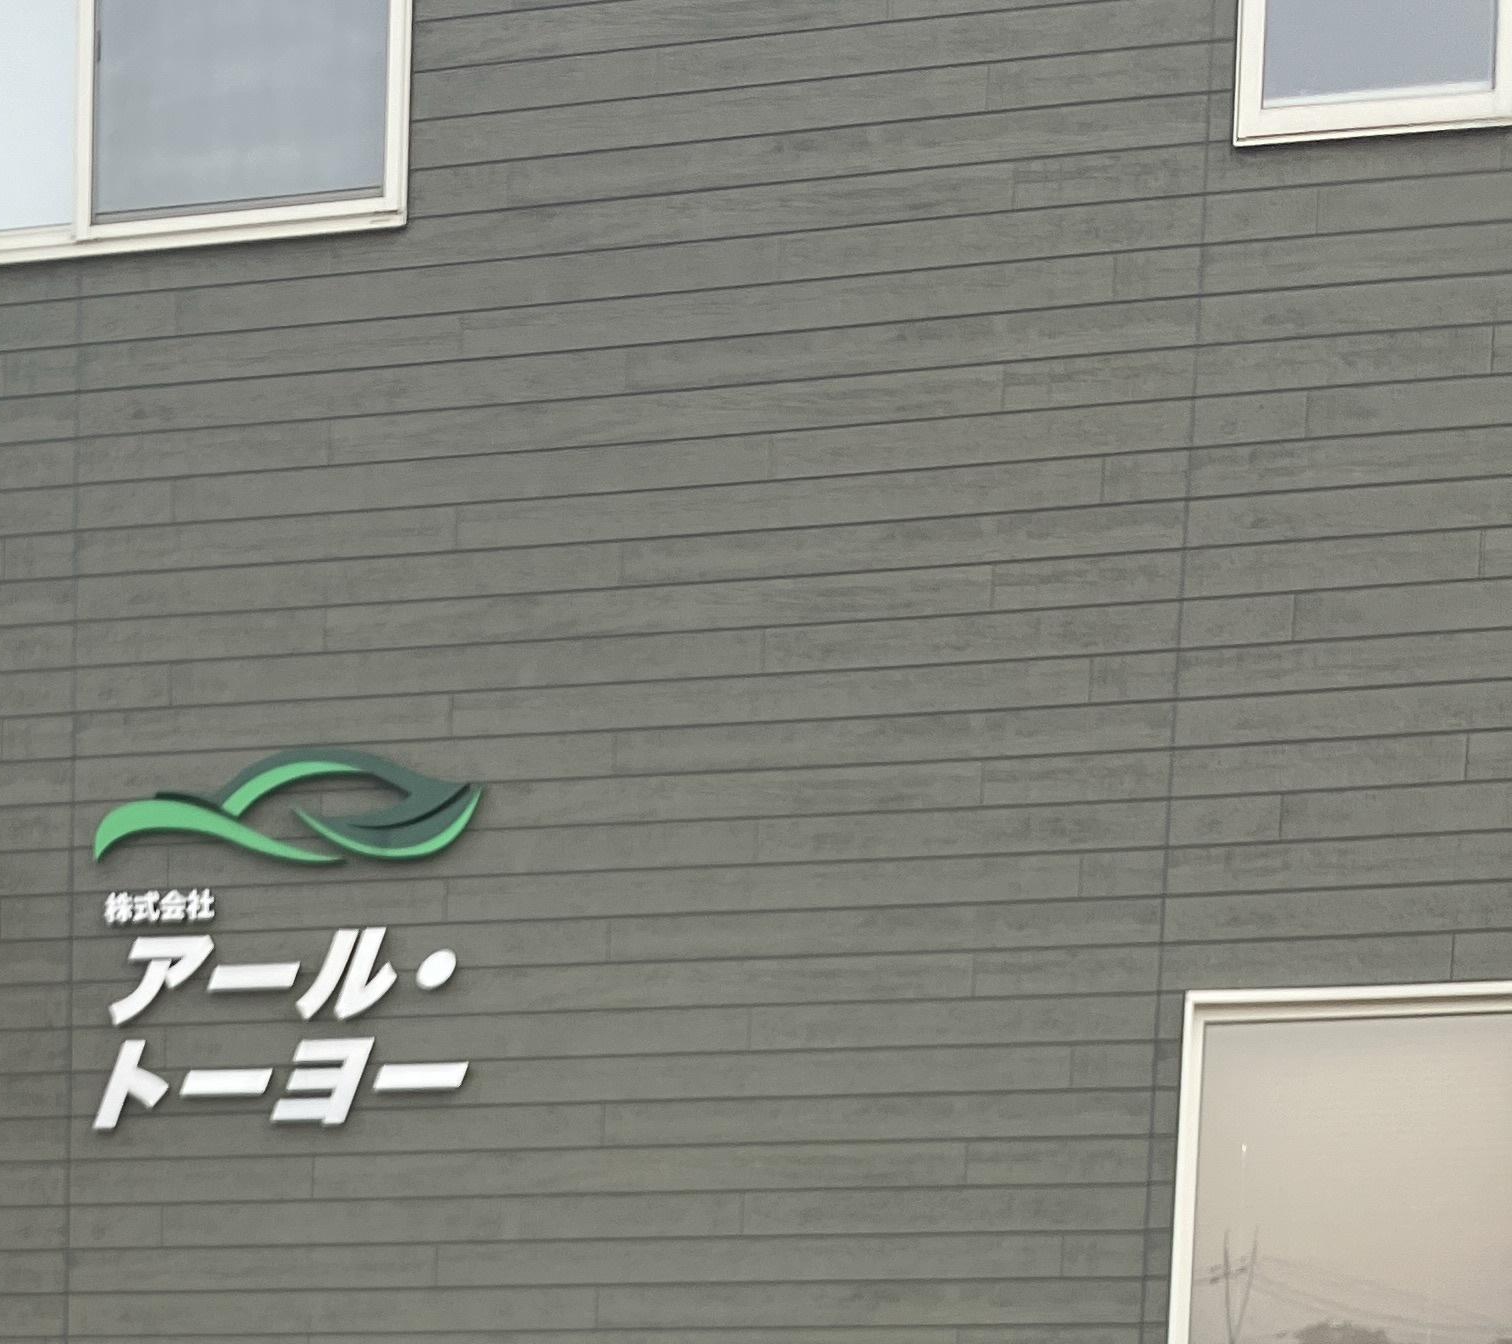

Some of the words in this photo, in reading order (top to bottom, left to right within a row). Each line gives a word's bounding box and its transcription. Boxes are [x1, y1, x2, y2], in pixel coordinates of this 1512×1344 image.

[104, 888, 216, 923] 株式会社
[107, 926, 458, 1027] アール・
[92, 1036, 470, 1131] トーヨー
